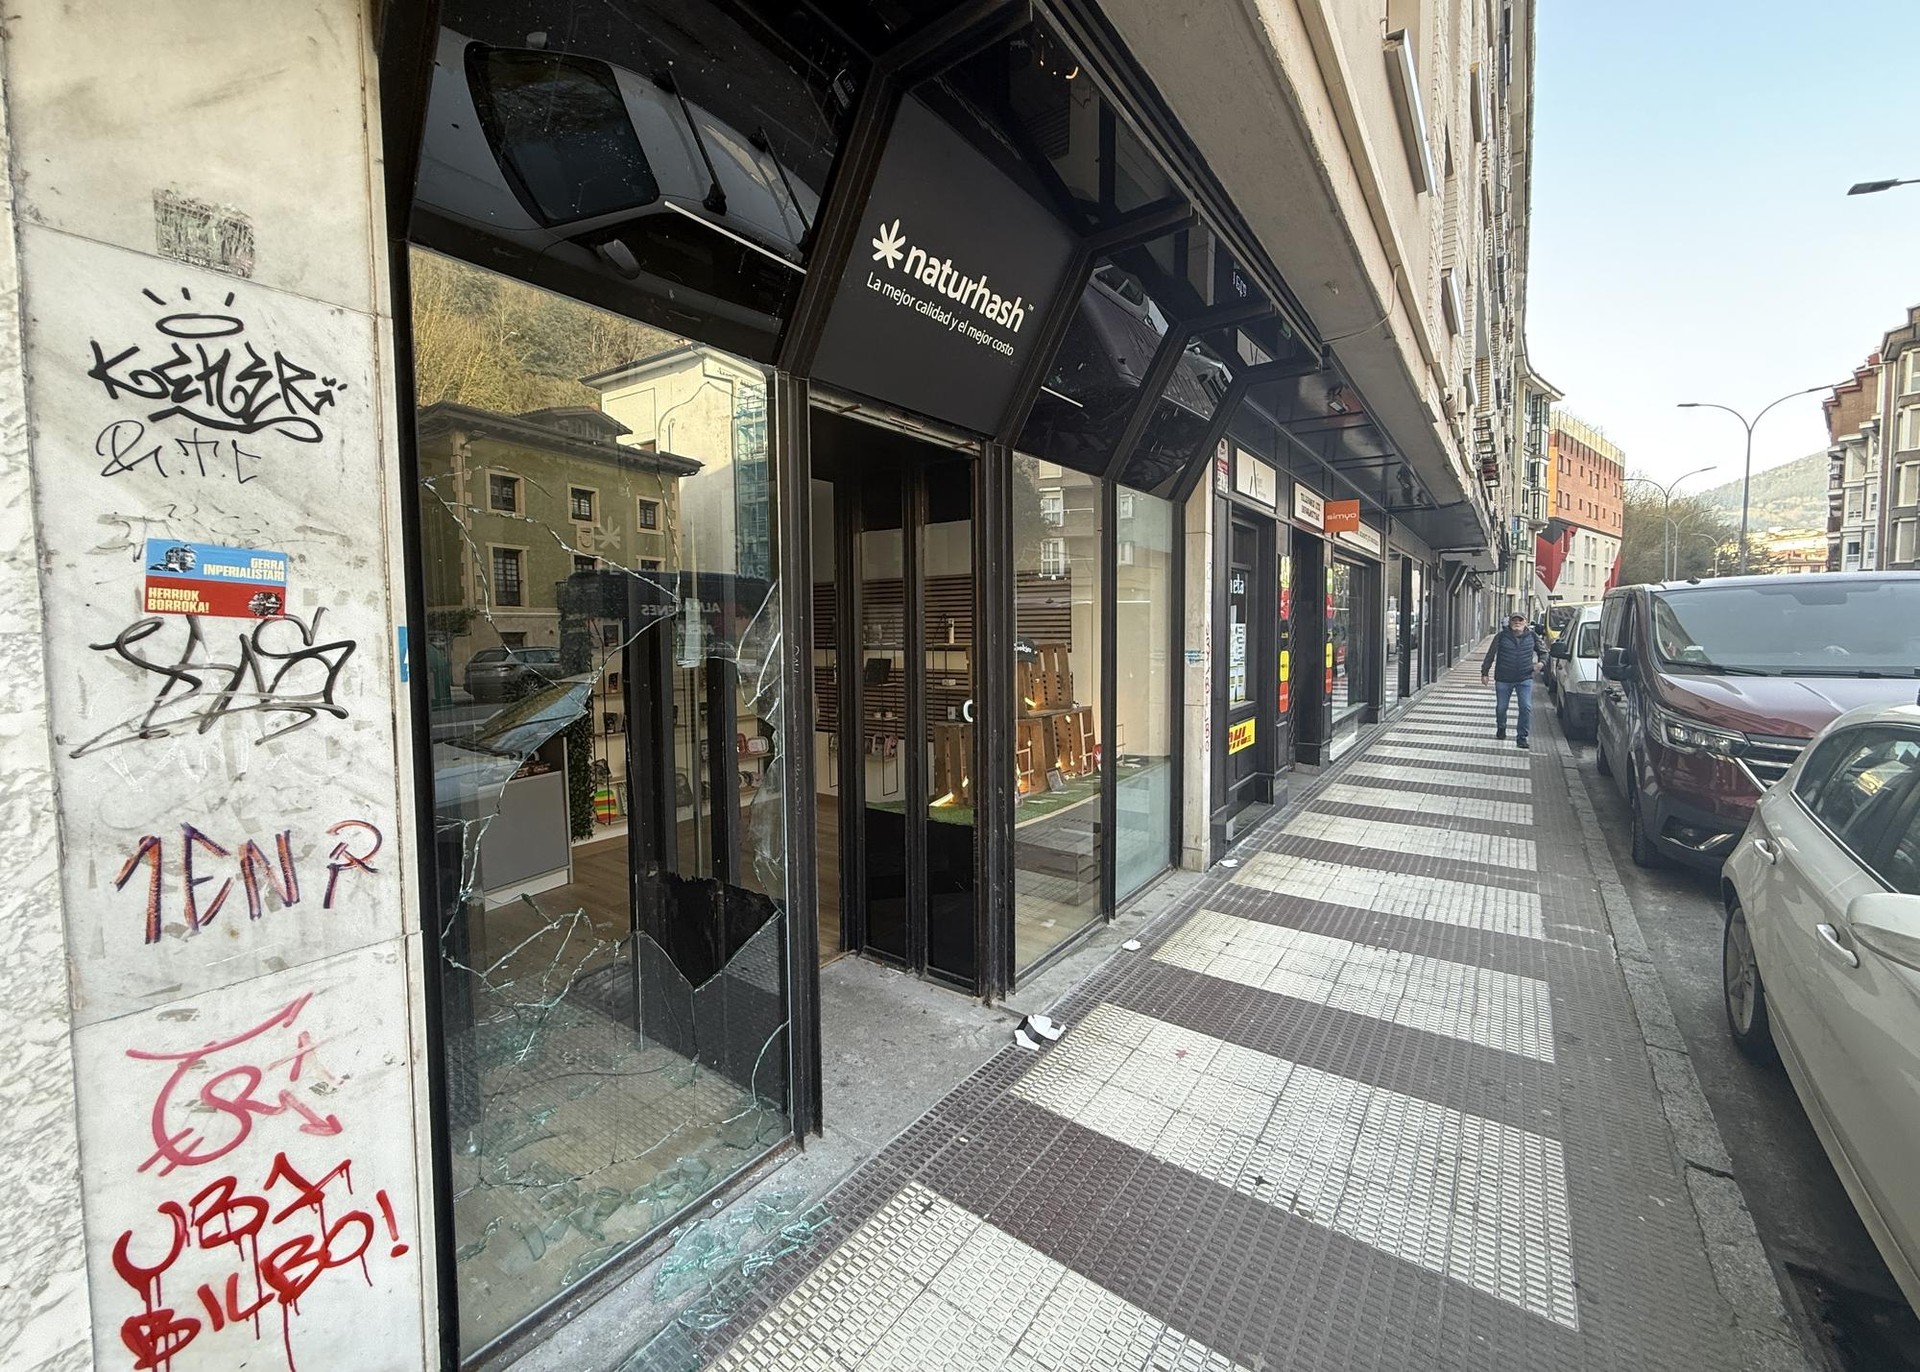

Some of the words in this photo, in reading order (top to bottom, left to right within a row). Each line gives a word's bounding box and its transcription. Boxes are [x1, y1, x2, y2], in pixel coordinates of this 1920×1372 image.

[903, 245, 1025, 333] naturhash
[867, 272, 882, 291] La
[882, 282, 916, 306] mejor
[915, 299, 951, 326] calidad
[949, 320, 957, 331] y
[957, 320, 969, 334] el
[967, 325, 993, 346] mejor
[992, 338, 1014, 356] costo
[1327, 512, 1357, 521] simyo
[250, 557, 285, 571] GERRA
[203, 563, 285, 582] INPERIALISTARI
[148, 587, 200, 601] HERRIOK
[147, 598, 210, 614] BORROKA!
